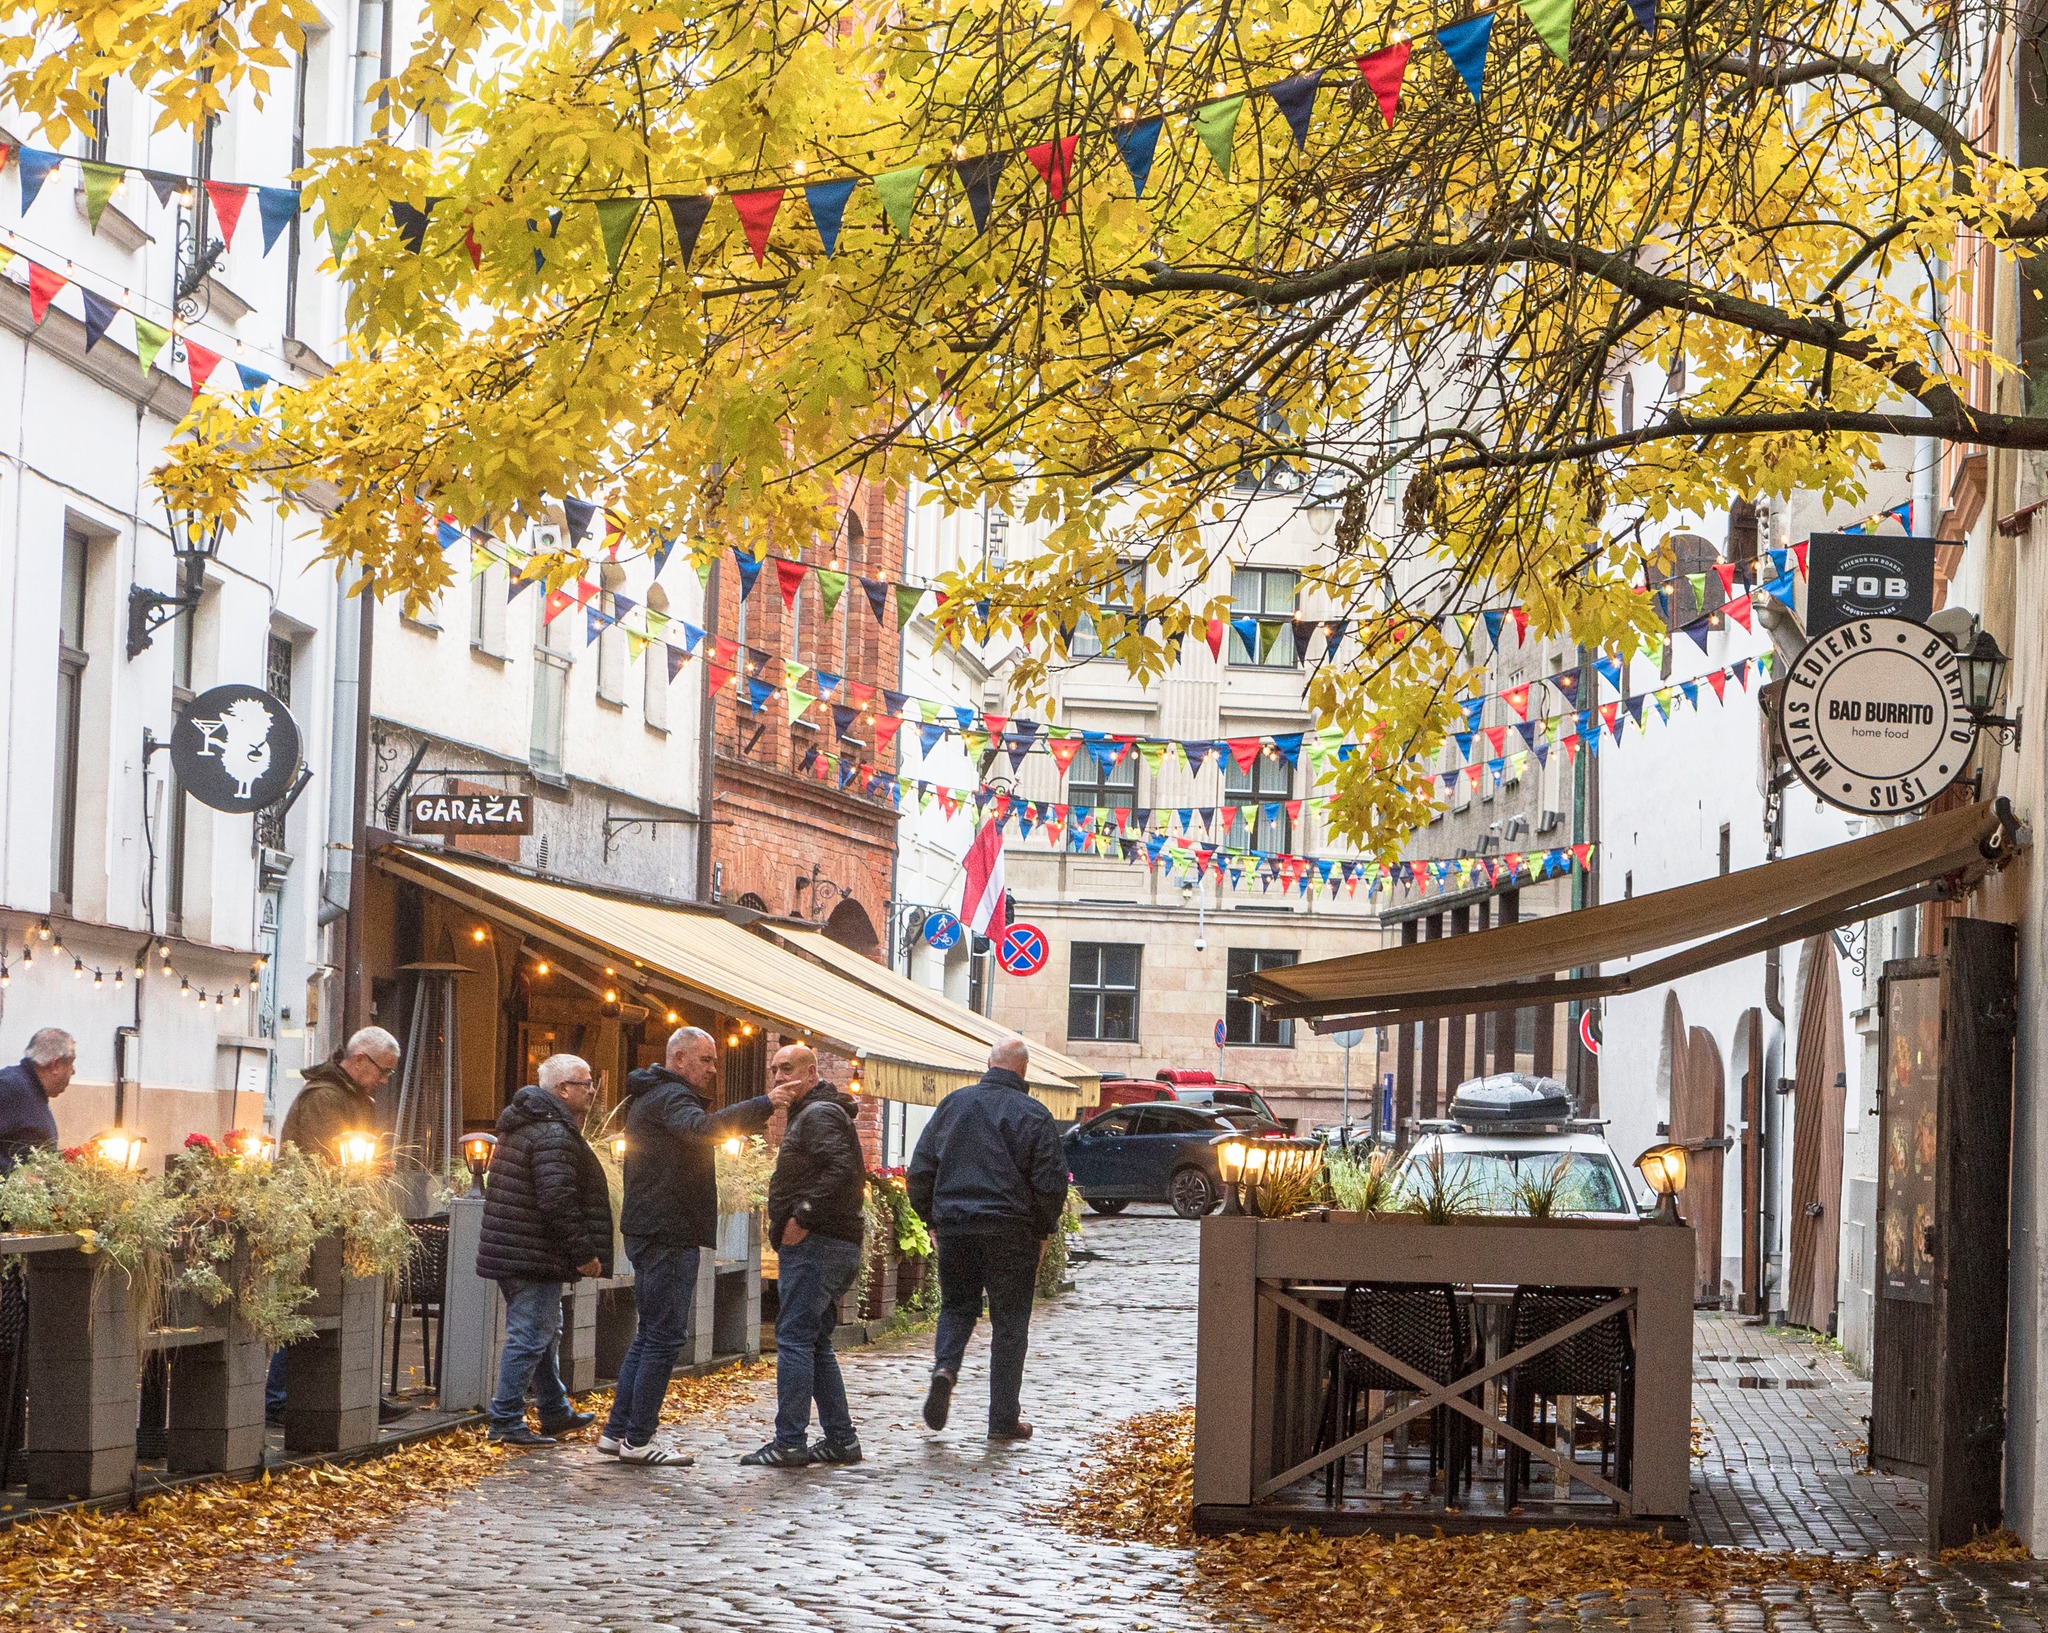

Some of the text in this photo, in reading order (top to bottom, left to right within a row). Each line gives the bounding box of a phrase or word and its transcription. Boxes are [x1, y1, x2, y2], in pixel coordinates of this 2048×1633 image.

[1840, 557, 1868, 570] FRIENDS
[1880, 558, 1902, 573] BOARD
[1831, 575, 1910, 599] FOB
[1788, 622, 1872, 782] MĀJAS ĒDIENS
[1829, 700, 1934, 725] BAD BURRITO
[1852, 726, 1909, 739] home food
[1870, 777, 1927, 808] SUŠI
[416, 795, 524, 825] GARĀŽA
